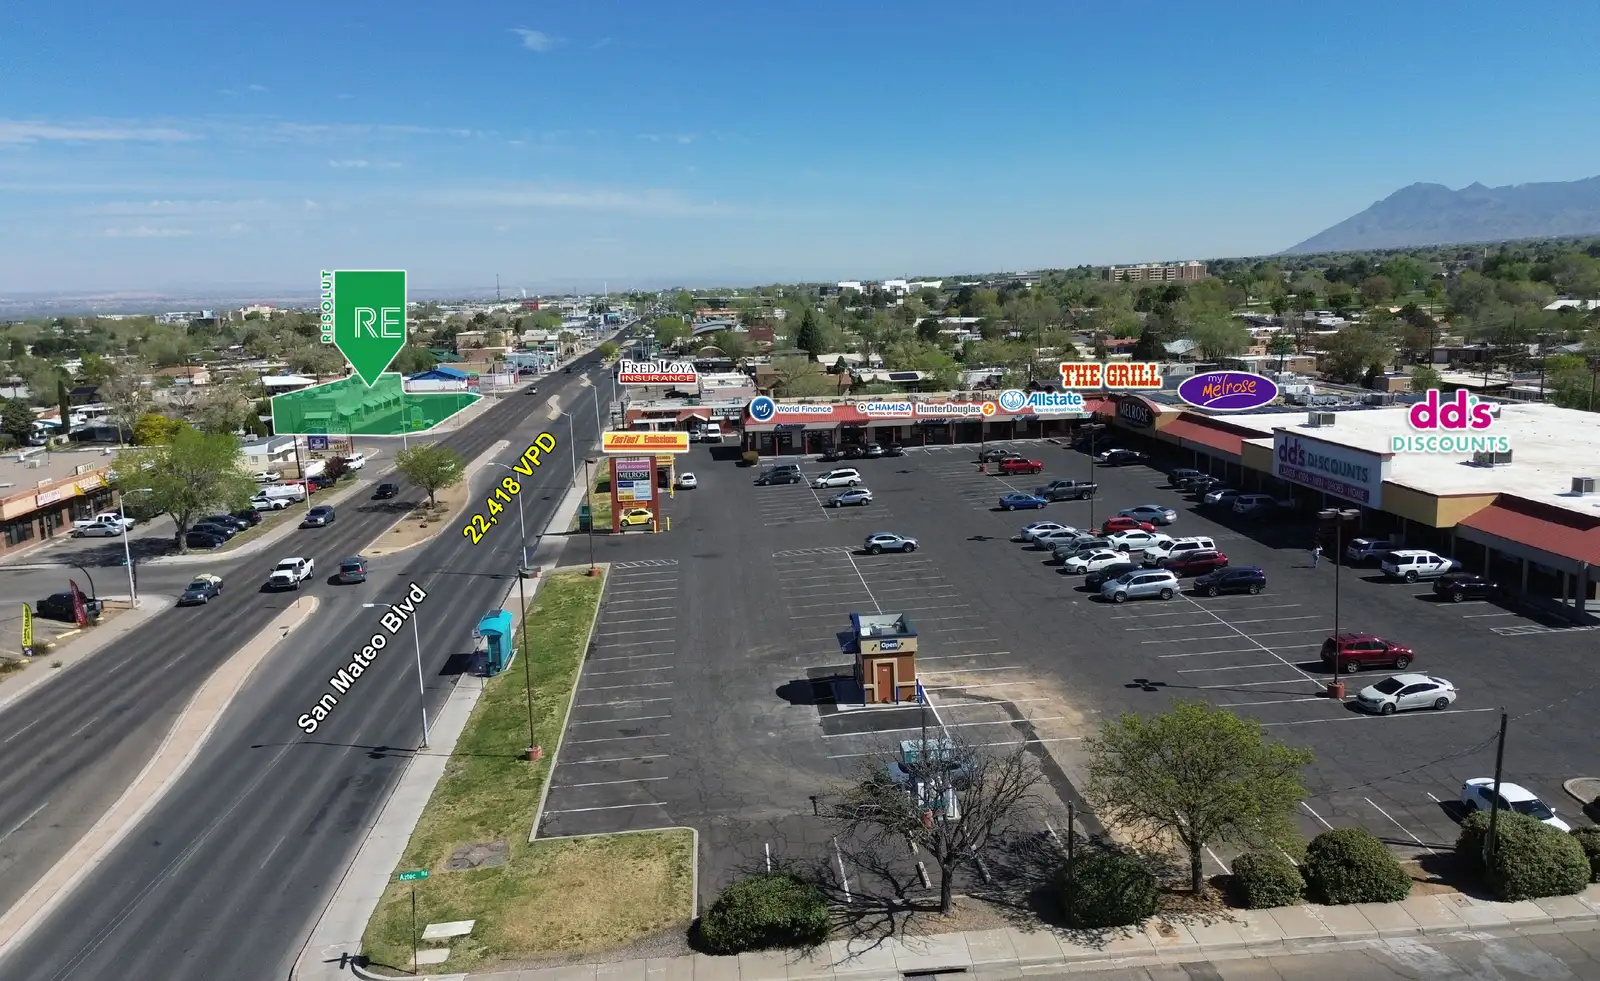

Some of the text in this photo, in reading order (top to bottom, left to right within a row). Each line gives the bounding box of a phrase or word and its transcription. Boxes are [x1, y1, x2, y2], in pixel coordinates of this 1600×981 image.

[1119, 401, 1149, 422] MELROSE
[618, 471, 649, 479] MELROSE
[1307, 452, 1369, 483] DISCOUNTS
